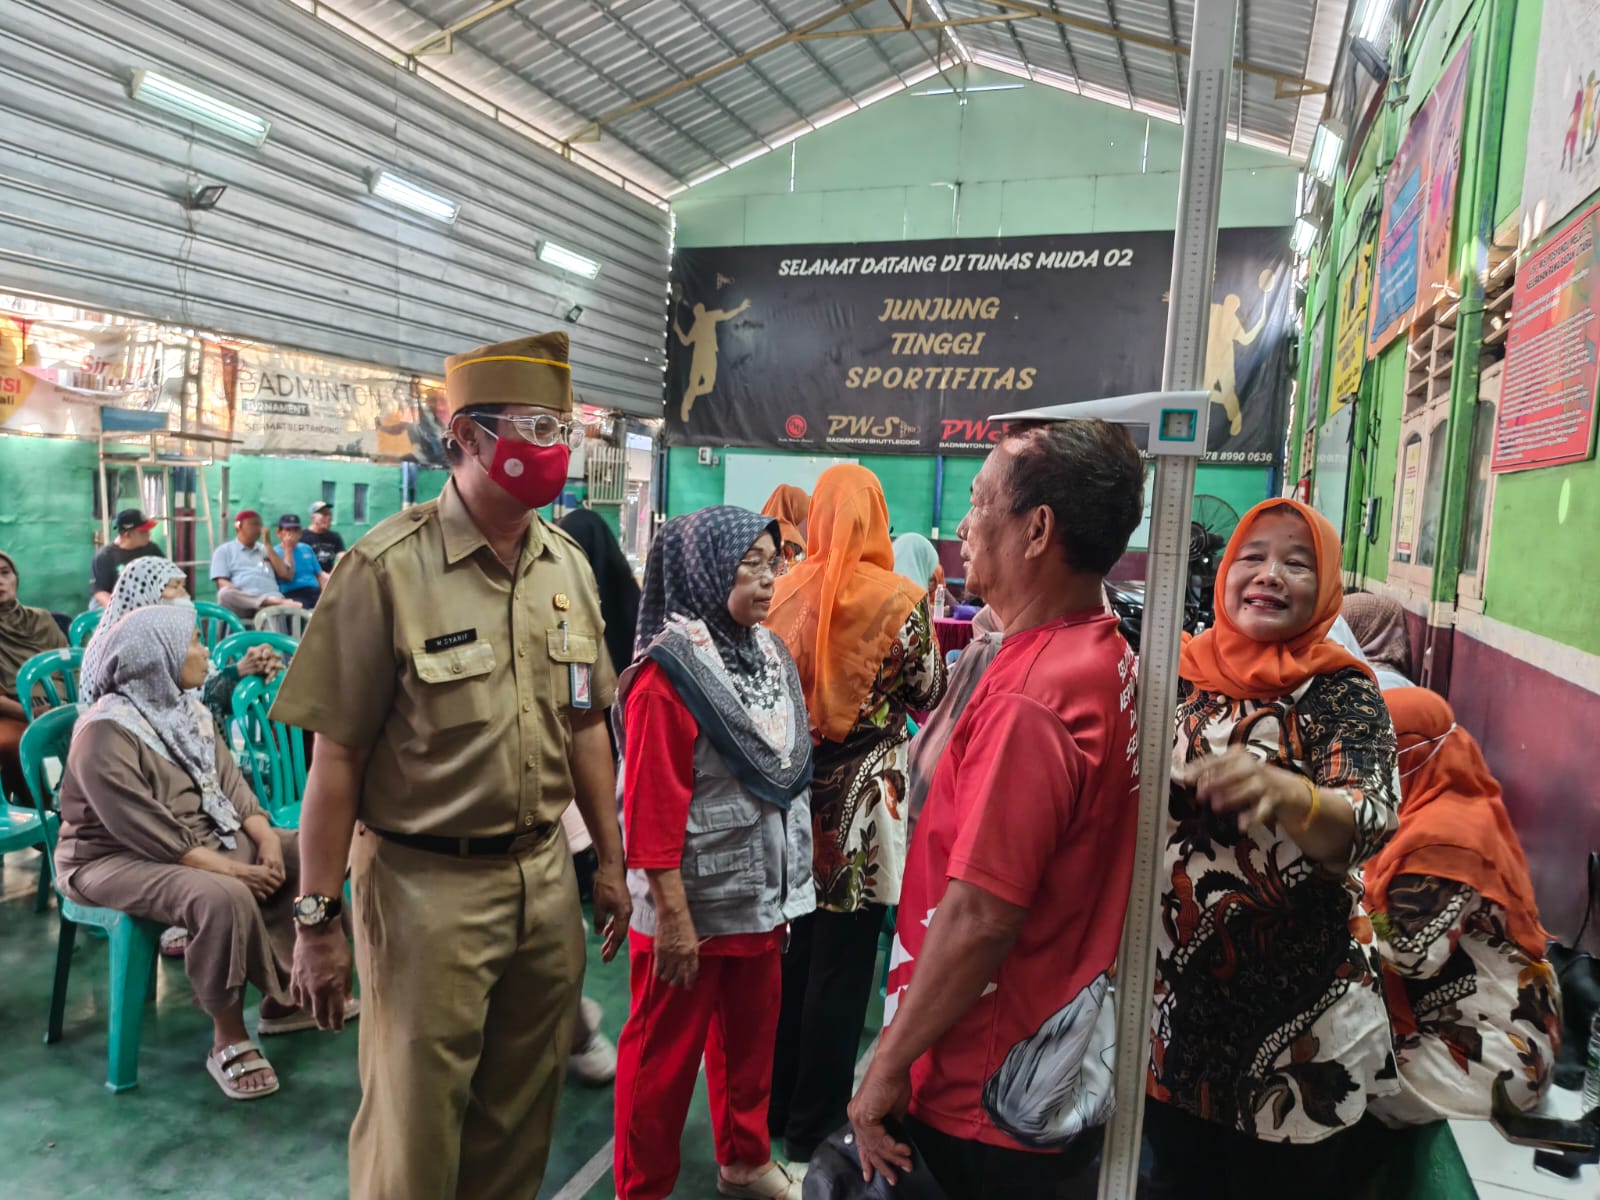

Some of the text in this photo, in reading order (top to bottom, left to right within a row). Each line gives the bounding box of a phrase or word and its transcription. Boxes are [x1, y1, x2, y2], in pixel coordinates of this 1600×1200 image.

[778, 248, 1134, 276] SELAMAT DATANG DI TUNAS MUDA 02
[878, 296, 1000, 322] JUNJUNG
[891, 331, 986, 355] TINGGI
[845, 366, 1037, 390] SPORTIFITAS
[827, 415, 900, 437] PWS
[869, 438, 921, 446] SHUTTLECOCK
[939, 441, 984, 449] BADMINTON
[1220, 451, 1245, 461] 8990
[1247, 452, 1272, 462] 0636
